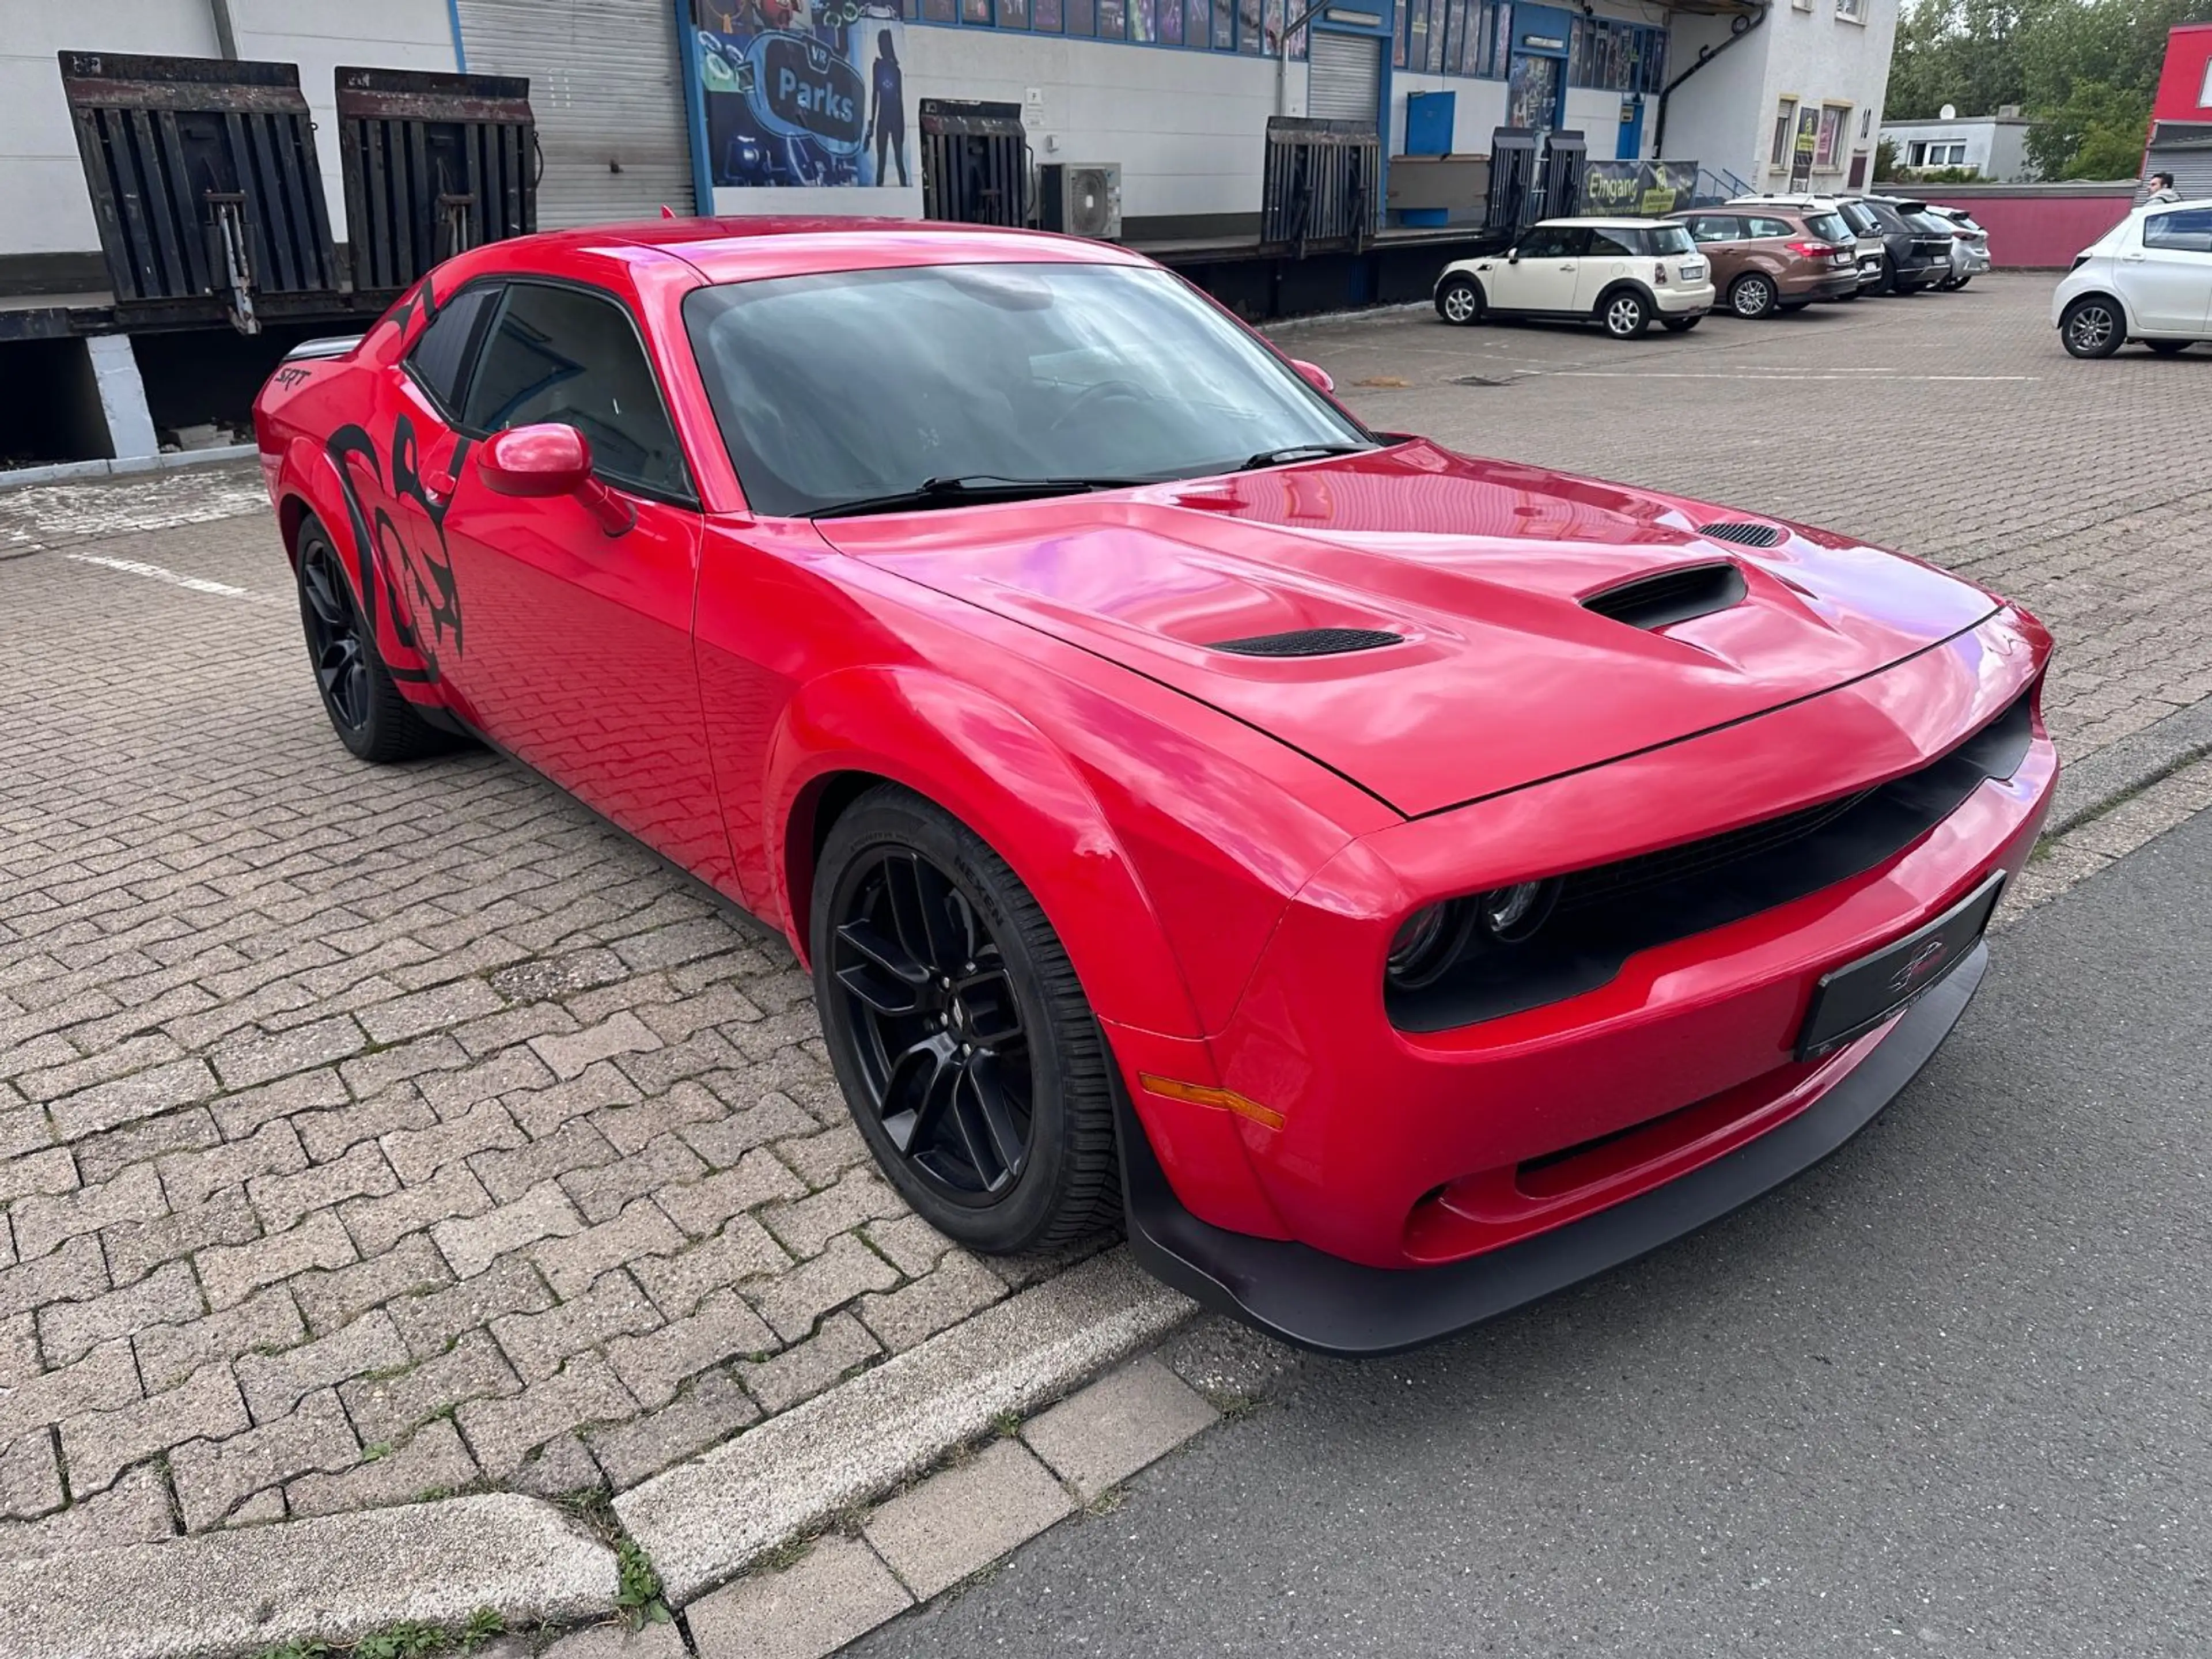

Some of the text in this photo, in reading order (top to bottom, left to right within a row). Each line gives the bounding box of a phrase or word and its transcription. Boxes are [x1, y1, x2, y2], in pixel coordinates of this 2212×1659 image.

[812, 45, 827, 64] VR
[779, 67, 853, 123] Parks
[1589, 173, 1638, 204] Eingang
[274, 368, 312, 391] SRT
[954, 854, 1003, 927] NEXEN
